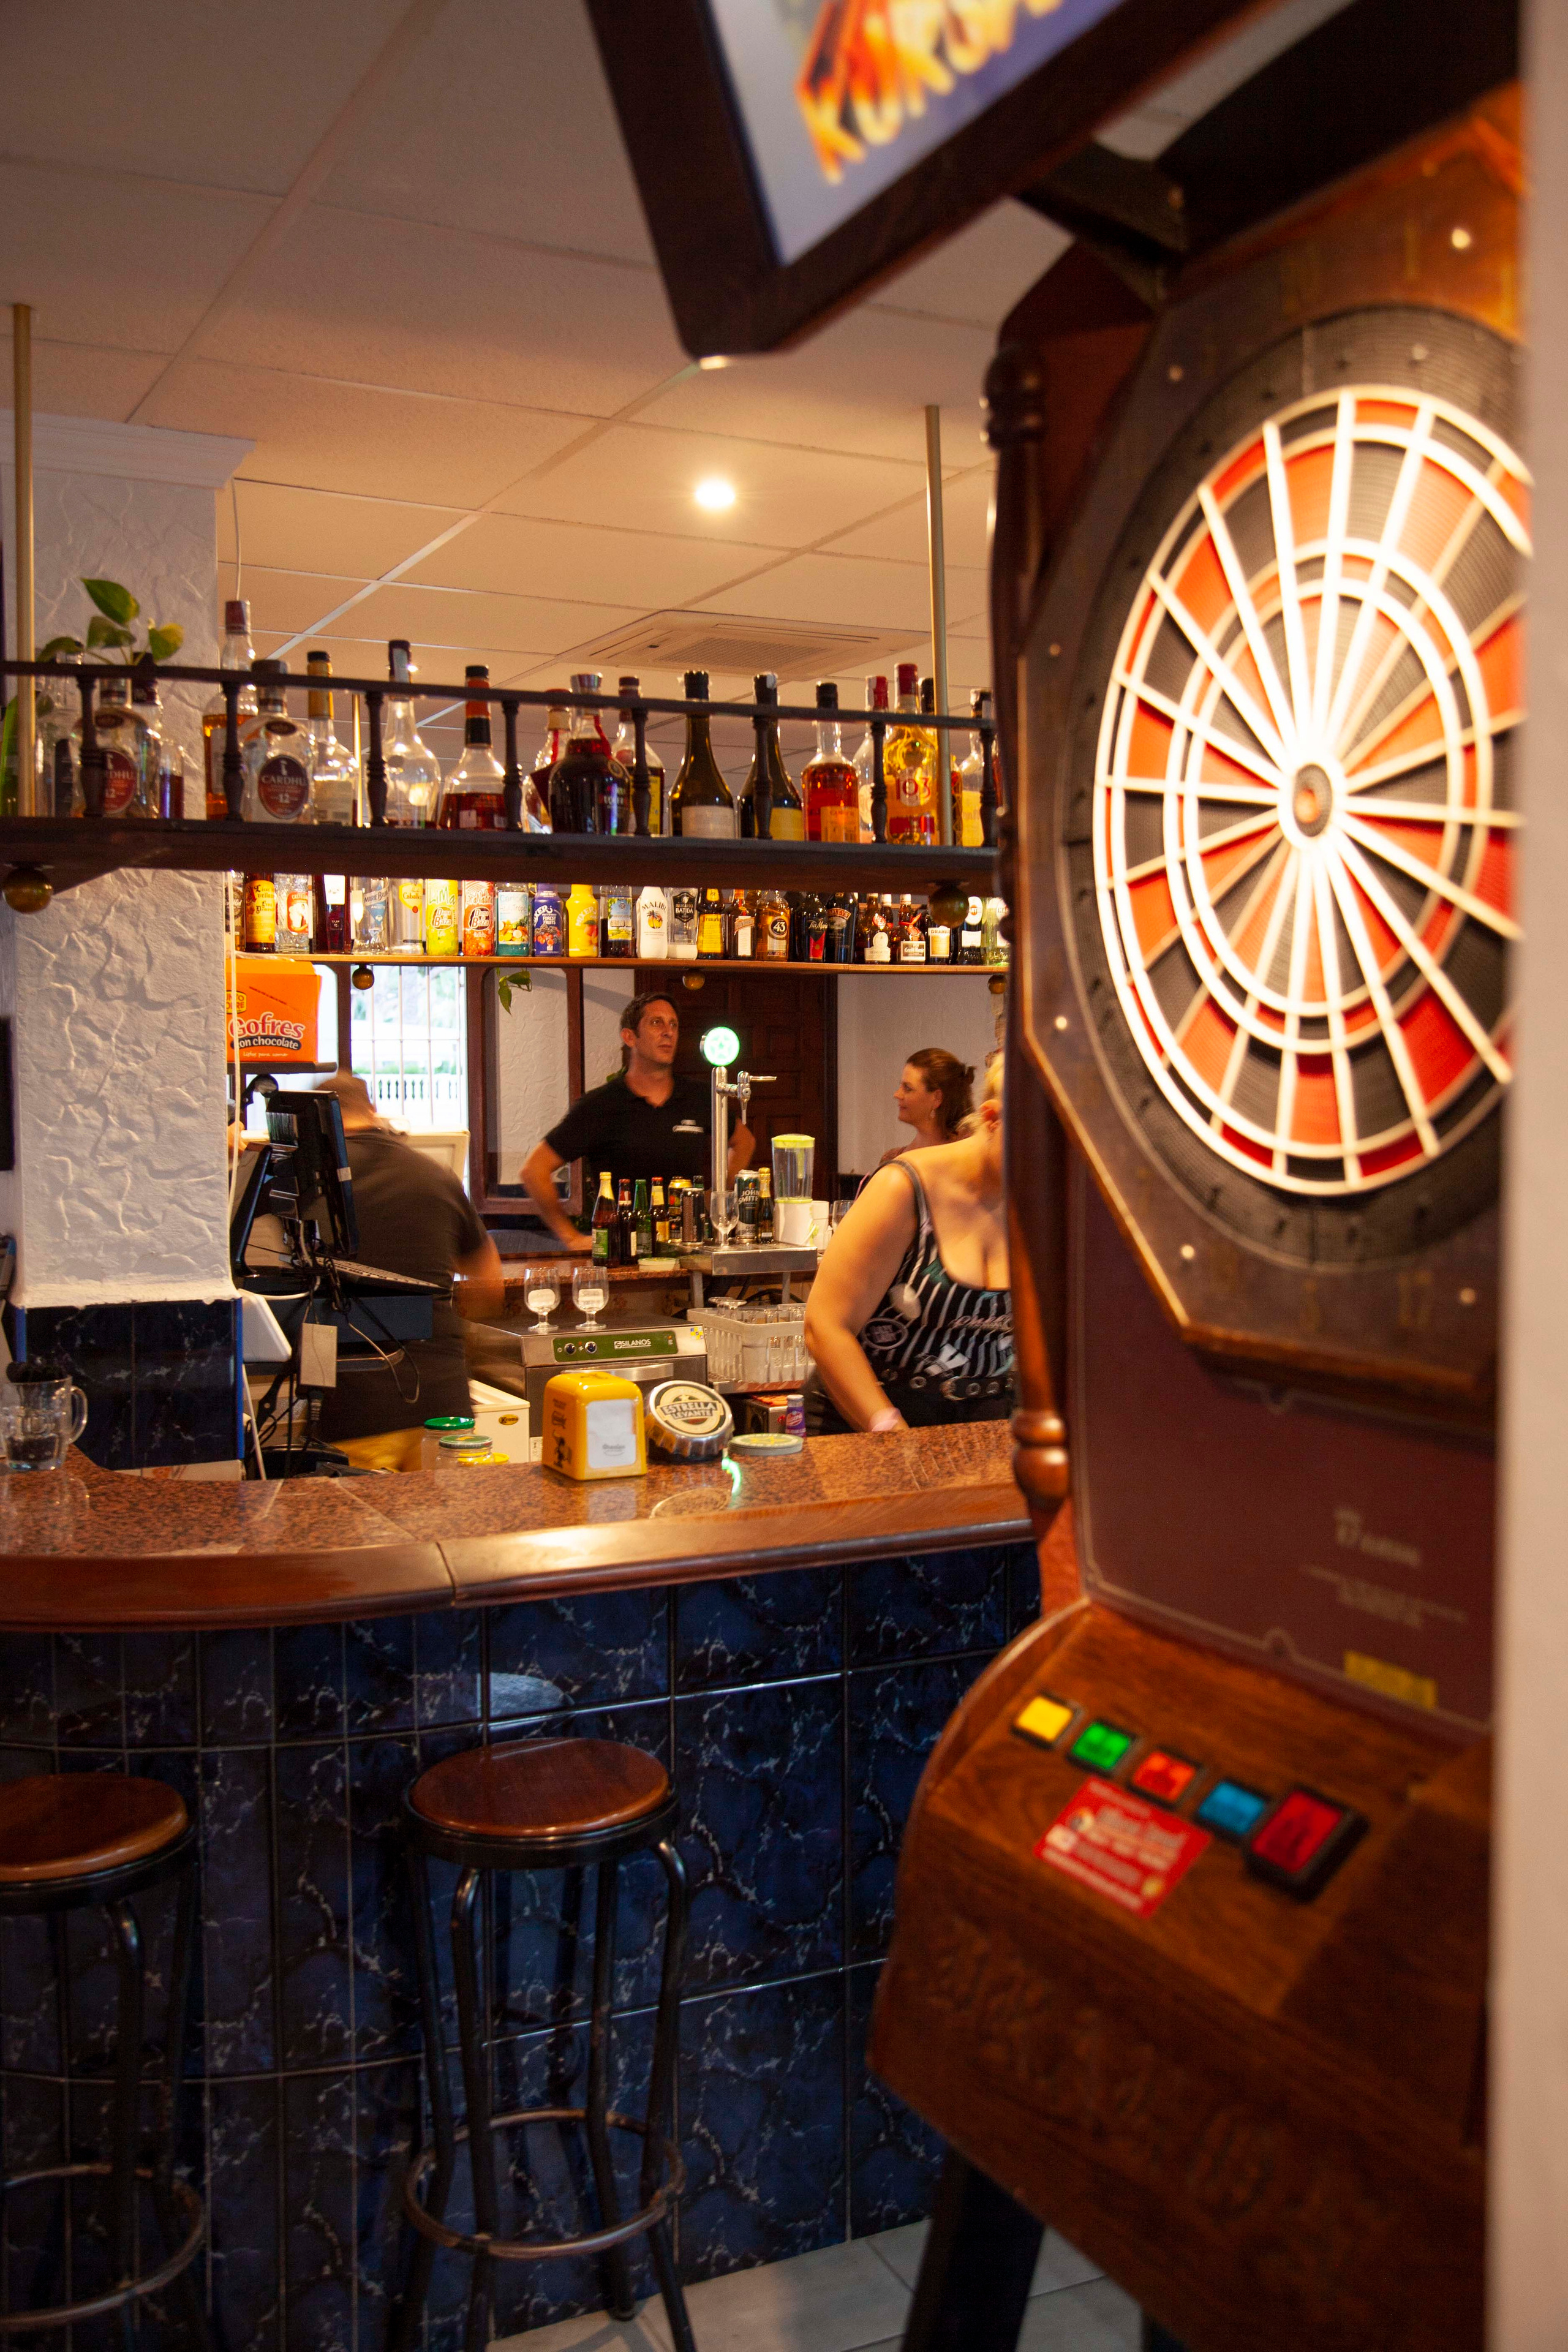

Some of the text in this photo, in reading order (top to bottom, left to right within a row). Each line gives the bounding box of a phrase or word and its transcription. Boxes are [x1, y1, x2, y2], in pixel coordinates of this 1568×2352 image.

[895, 777, 930, 800] 103
[436, 908, 452, 916] Dama
[434, 916, 453, 928] Baza
[472, 916, 490, 929] Baza
[773, 921, 786, 932] 43
[228, 1012, 305, 1039] Gofres
[252, 1036, 299, 1050] chocolate
[621, 1338, 651, 1348] SILANOS
[661, 1401, 716, 1415] ESTRELLA
[671, 1409, 712, 1420] LEVANTE
